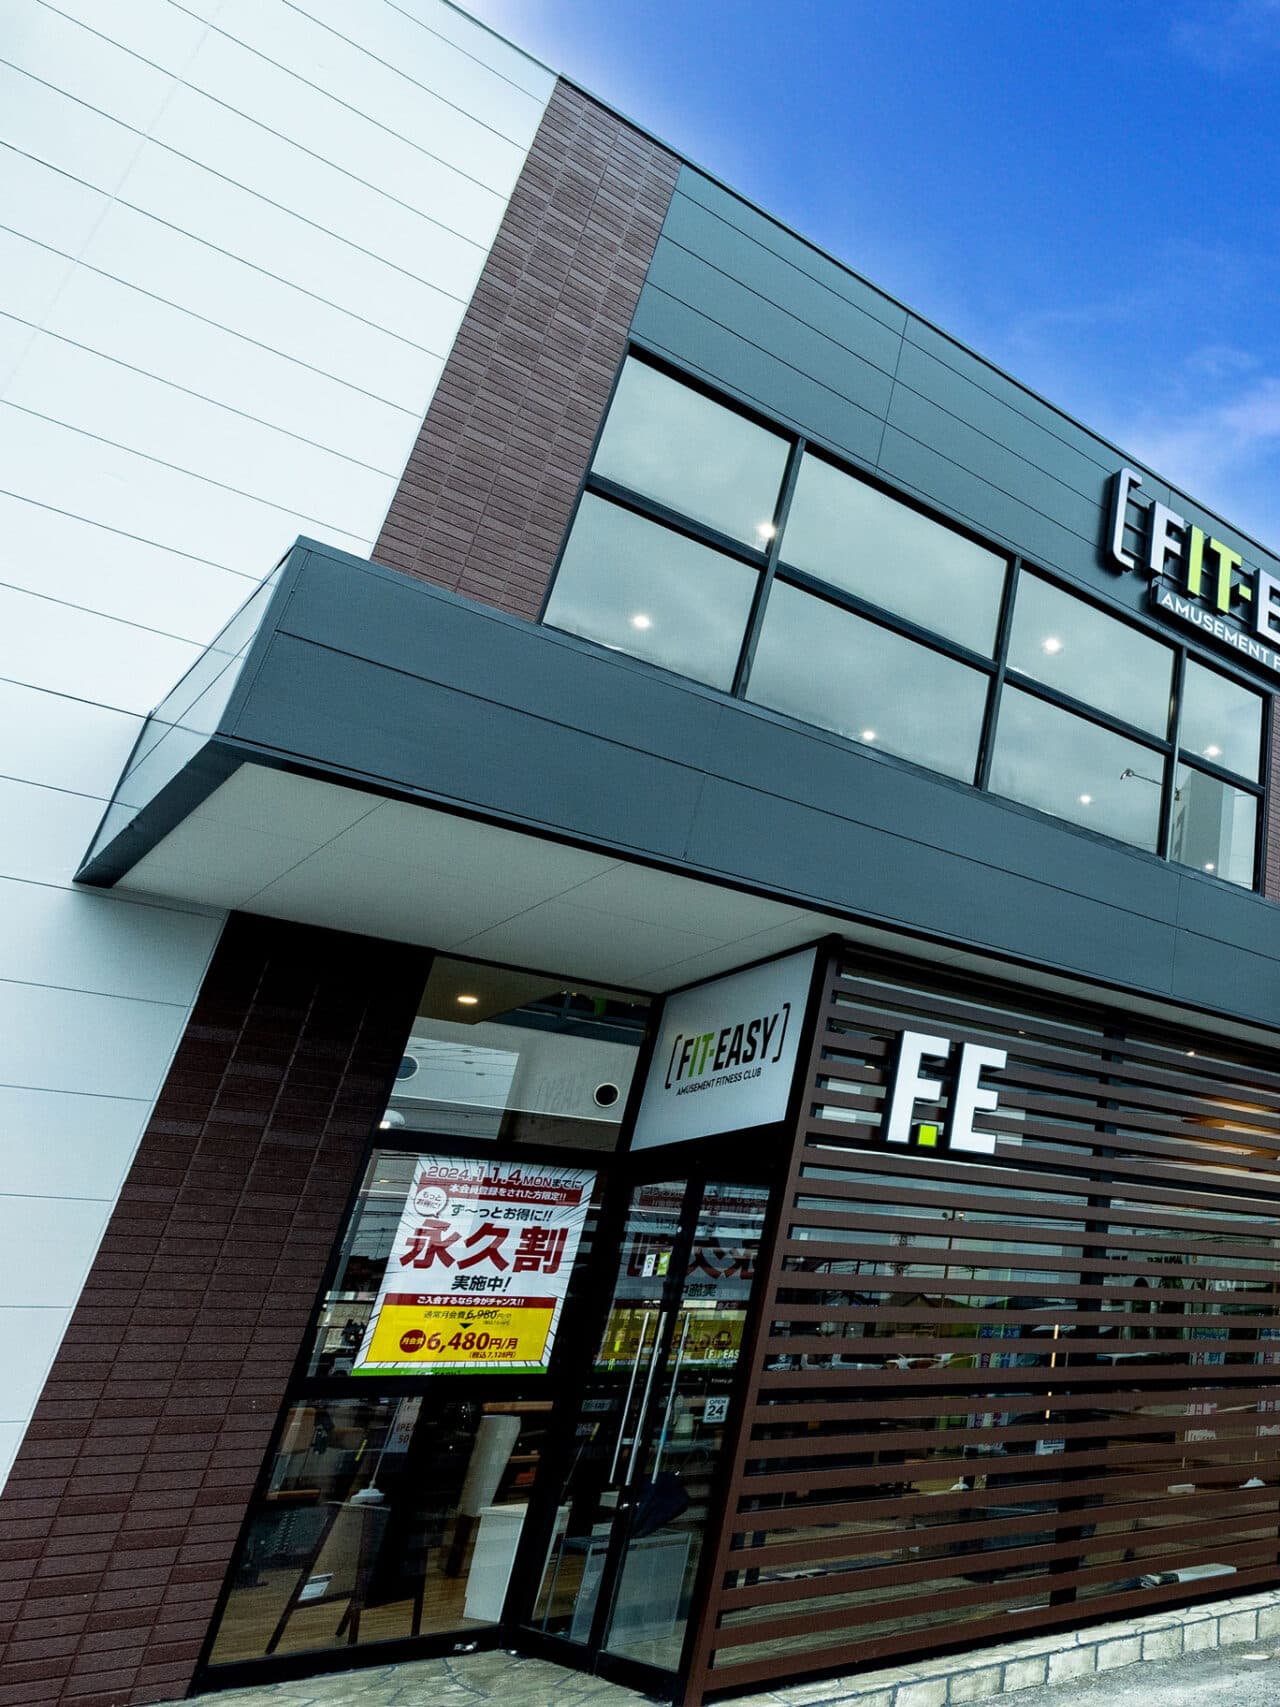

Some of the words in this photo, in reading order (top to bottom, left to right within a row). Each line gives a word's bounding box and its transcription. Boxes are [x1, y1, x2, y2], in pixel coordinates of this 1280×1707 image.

[1161, 592, 1271, 665] AMUSEMENT
[675, 1078, 716, 1097] AMUSEMENT
[715, 1071, 743, 1088] FITNESS
[743, 1067, 762, 1080] CLUB
[399, 1218, 570, 1275] 永久割
[450, 1275, 512, 1292] 実施中!
[426, 1331, 519, 1354] 6,480円/月
[707, 1405, 724, 1416] 24
